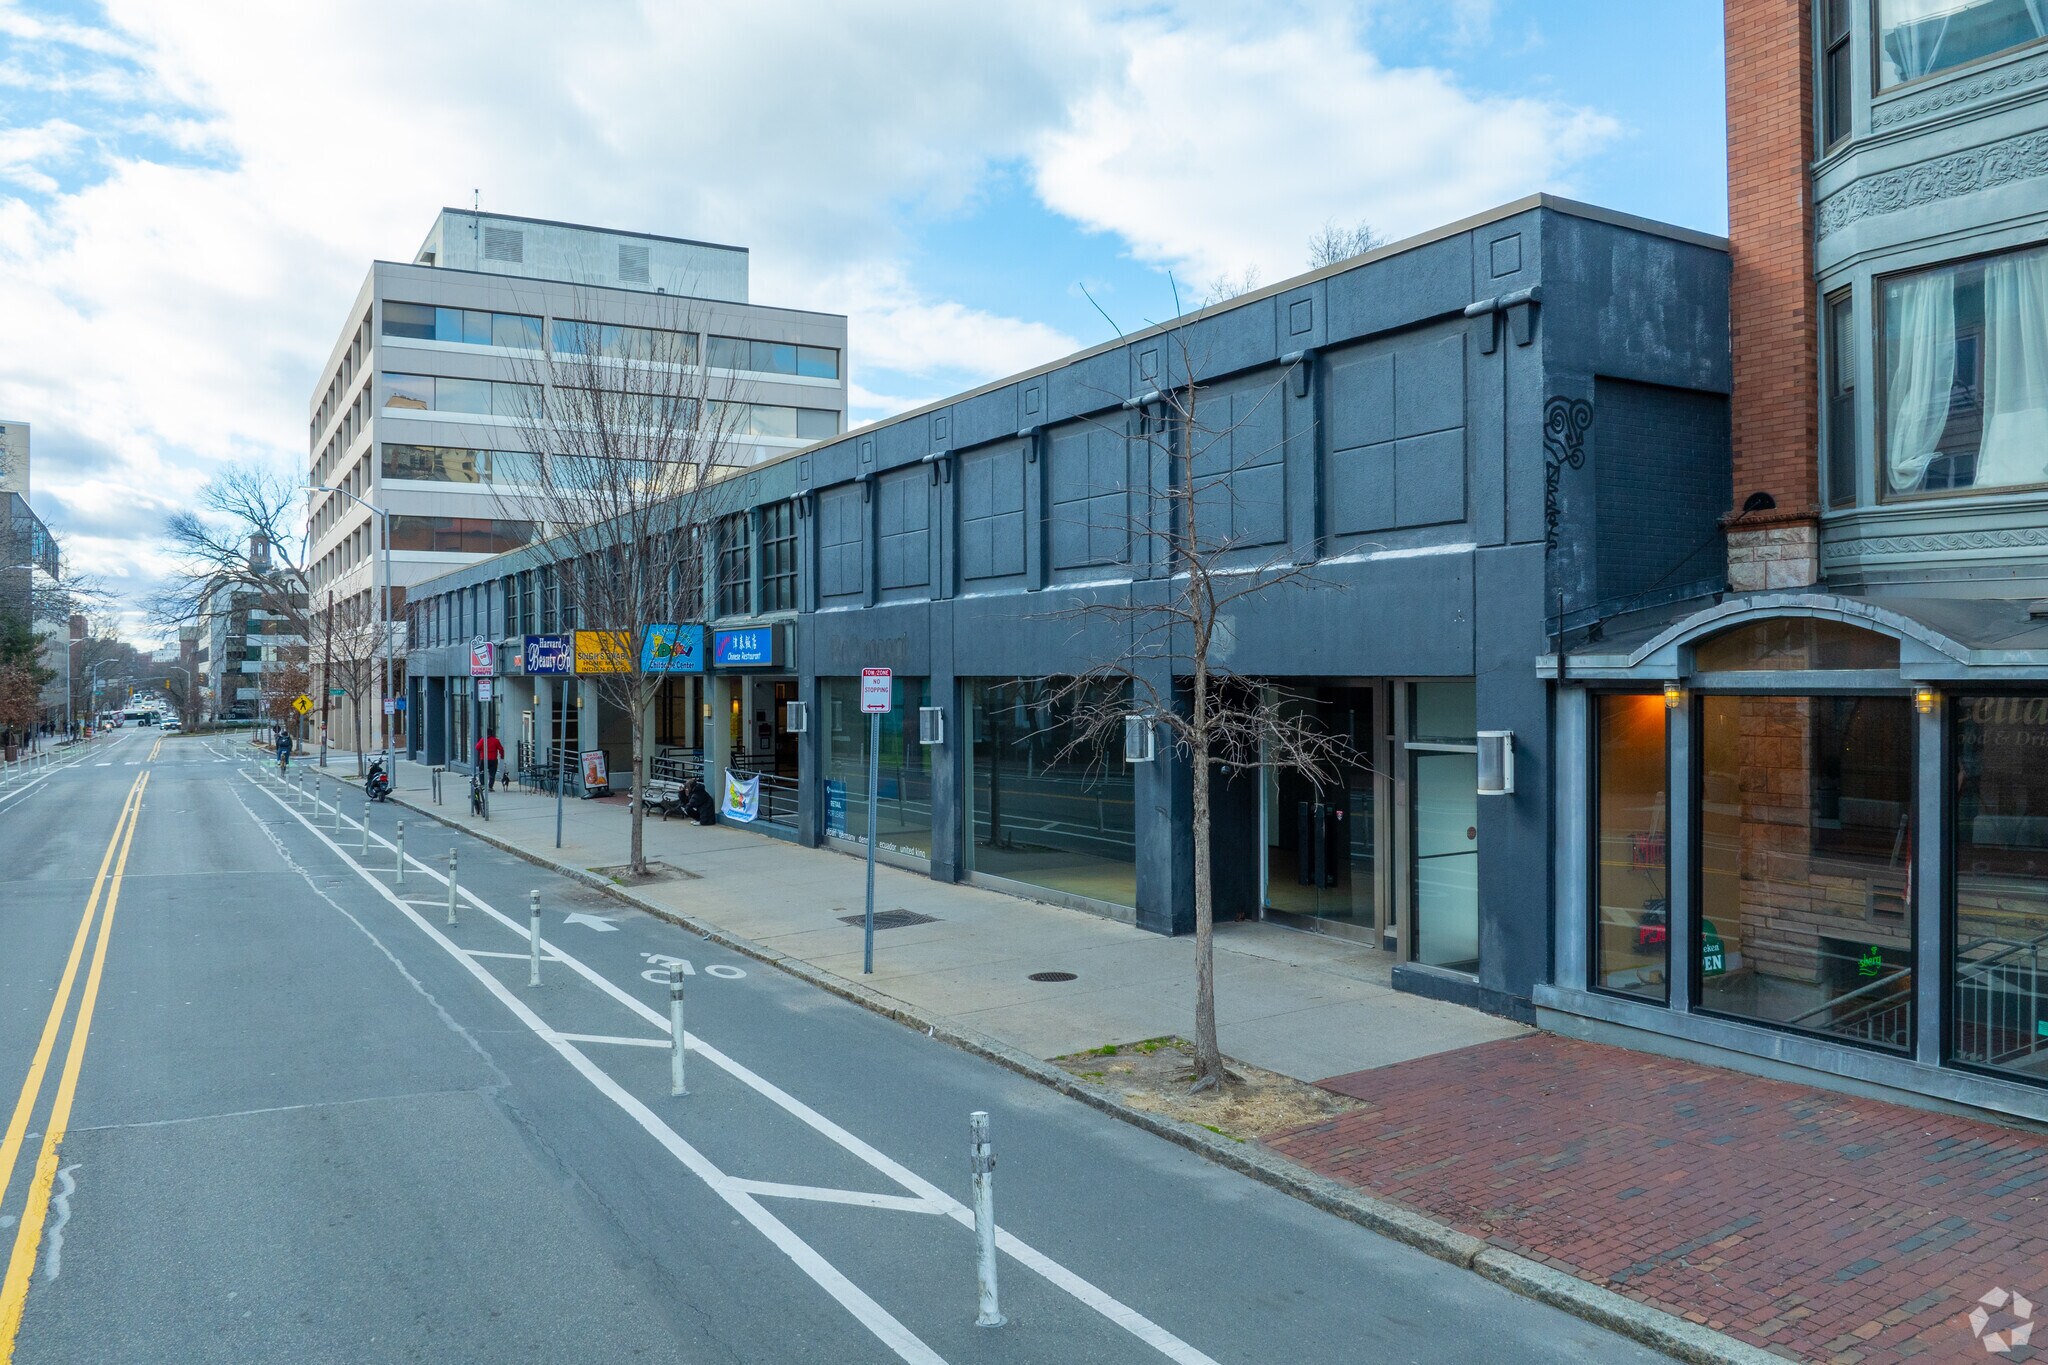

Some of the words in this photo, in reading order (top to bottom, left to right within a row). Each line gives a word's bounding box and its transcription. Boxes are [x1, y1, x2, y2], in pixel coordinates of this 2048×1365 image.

[539, 638, 562, 648] Harvard
[528, 643, 556, 672] Beauty
[728, 652, 741, 661] Chinese
[741, 651, 762, 660] Restaurant
[676, 661, 695, 669] Center
[879, 841, 897, 851] ecuador
[900, 845, 915, 856] united
[1703, 955, 1722, 971] EN
